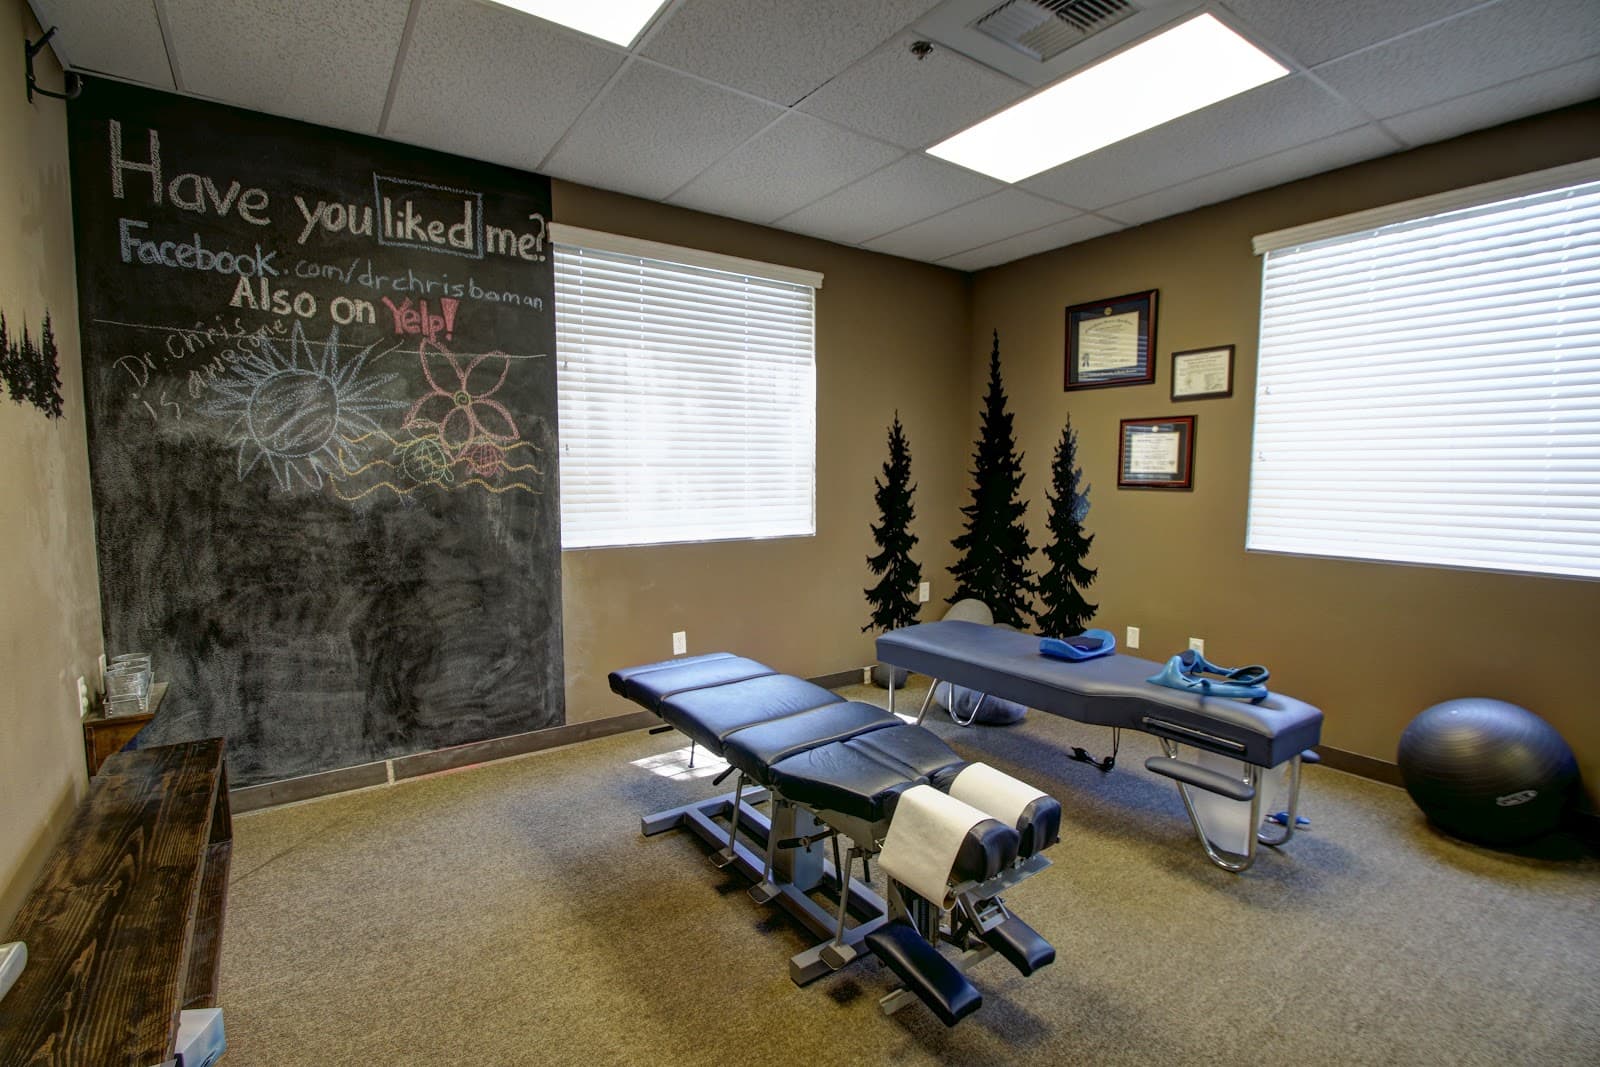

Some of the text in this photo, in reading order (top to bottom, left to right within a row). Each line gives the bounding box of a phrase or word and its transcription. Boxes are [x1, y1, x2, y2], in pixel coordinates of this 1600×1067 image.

[109, 119, 546, 262] Have you liked me?
[229, 275, 460, 341] Also on Yelp!
[113, 315, 246, 389] Dr. Chris
